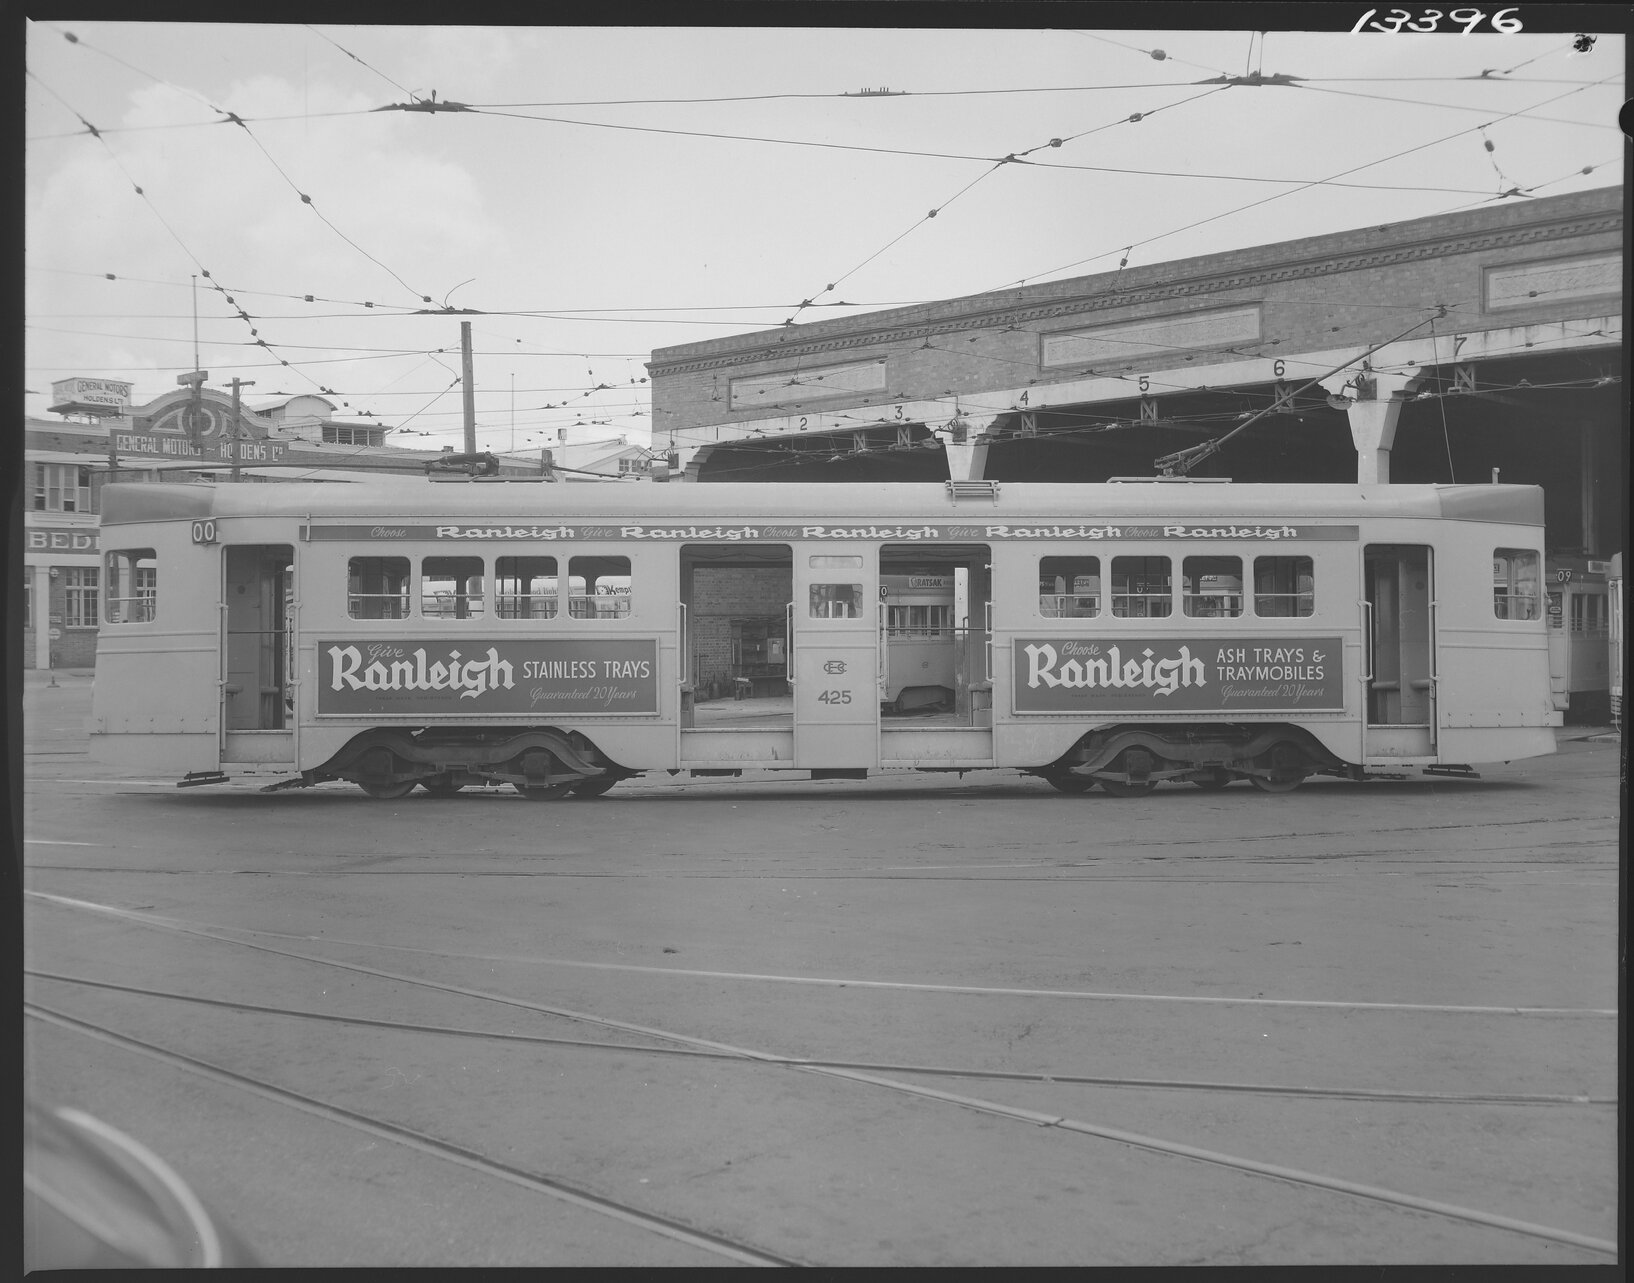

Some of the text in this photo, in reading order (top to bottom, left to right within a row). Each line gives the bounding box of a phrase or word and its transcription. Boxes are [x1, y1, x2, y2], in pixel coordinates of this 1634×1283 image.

[1454, 337, 1467, 356] 7
[1274, 359, 1285, 376] 6
[77, 380, 103, 393] GENERAL
[105, 383, 129, 397] MOTORS
[1139, 375, 1149, 392] 5
[1019, 390, 1029, 404] 4
[894, 406, 903, 420] 3
[799, 417, 808, 431] 2
[715, 426, 720, 441] 1
[116, 434, 159, 454] GENERAL
[220, 442, 266, 460] HODEN'S
[193, 522, 214, 541] 00
[371, 525, 1298, 540] Choose Ranleigh Give Ranleigh Choose Ranleigh Give Ranleigh Choose Ranleigh
[917, 578, 942, 587] RATSAK
[1557, 571, 1571, 581] 09
[367, 643, 405, 664] Give
[1061, 641, 1101, 656] Choose
[1216, 648, 1326, 663] ASH TRAYS &
[327, 645, 517, 700] Ranleigh
[523, 660, 650, 680] STAINLESS TRAYS
[1024, 643, 1207, 697] Ranleigh
[1216, 666, 1325, 681] TRAYMOBILES
[529, 687, 592, 708] Guaranteed
[593, 686, 607, 699] 20
[818, 690, 852, 704] 425
[1221, 684, 1281, 705] Guaranteed
[1282, 684, 1295, 697] 20
